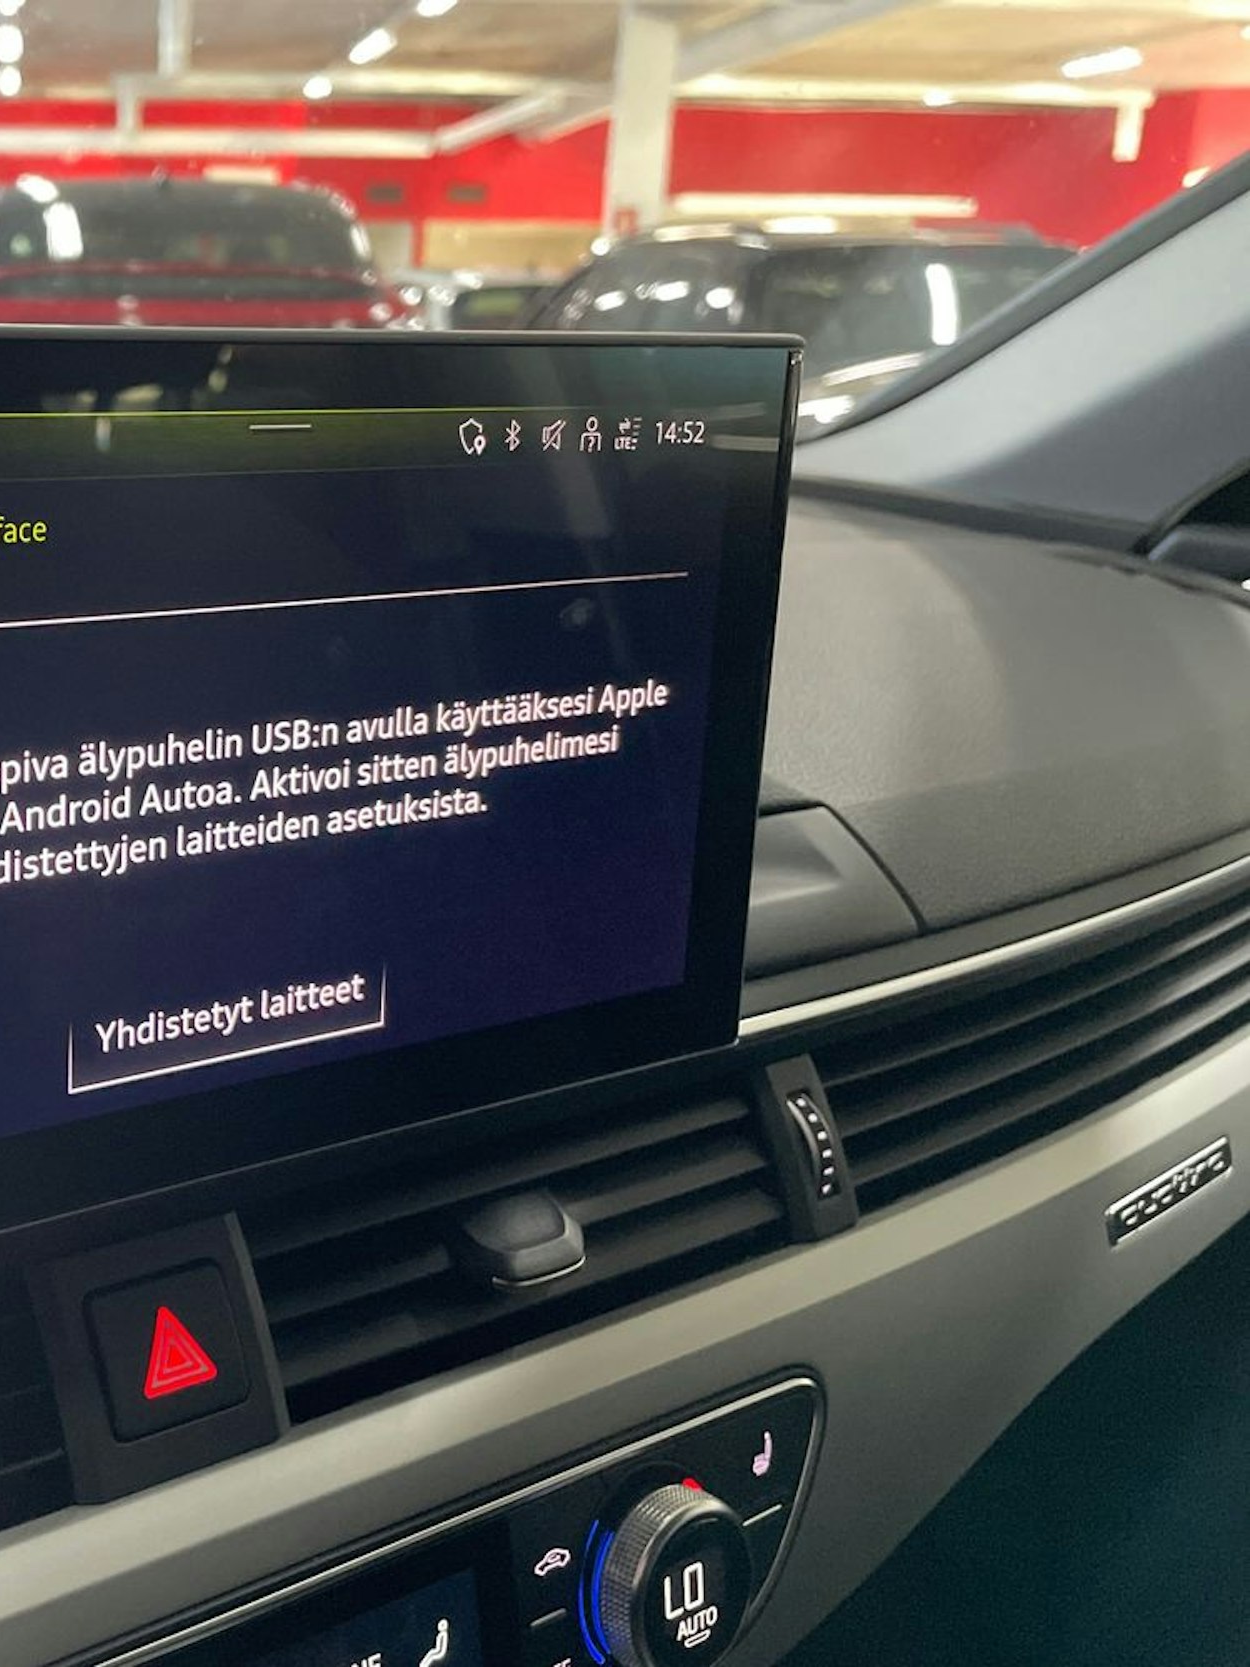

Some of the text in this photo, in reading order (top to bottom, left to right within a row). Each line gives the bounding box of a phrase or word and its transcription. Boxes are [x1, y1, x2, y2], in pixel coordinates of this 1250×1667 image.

[655, 420, 704, 445] 14:52
[78, 727, 243, 782] älypuhelin
[252, 719, 339, 755] USB:n
[347, 706, 428, 744] avulla
[437, 687, 594, 736] käyttääksesi
[599, 679, 668, 718] Apple
[0, 786, 132, 836] Android
[139, 779, 242, 816] Autoa.
[250, 760, 351, 801] Aktivoi
[356, 749, 436, 788] sitten
[444, 725, 619, 778] älypuhelimesi
[176, 812, 320, 856] laitteiden
[327, 786, 488, 836] asetuksista.
[96, 973, 366, 1053] Yhdistetyt laitteet
[663, 1560, 705, 1621] LO
[676, 1604, 719, 1642] AUTO
